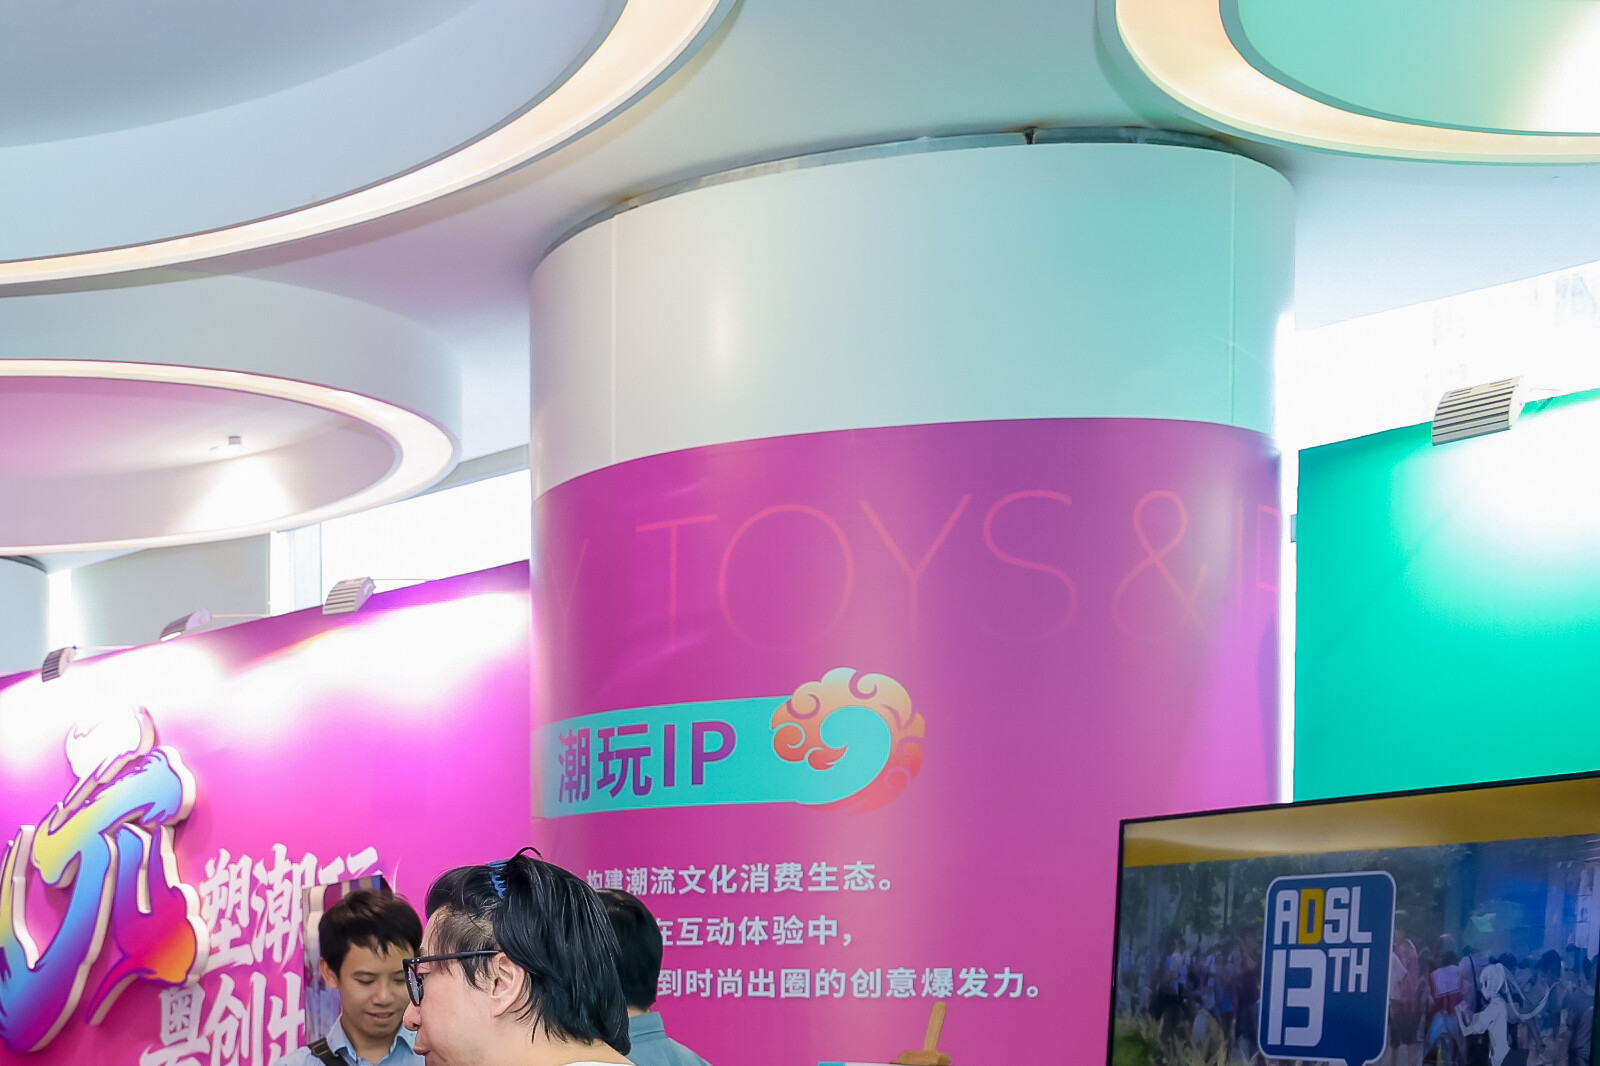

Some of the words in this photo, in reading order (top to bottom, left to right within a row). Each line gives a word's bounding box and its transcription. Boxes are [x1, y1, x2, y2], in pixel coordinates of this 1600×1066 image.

[635, 490, 1079, 652] TOYS
[557, 719, 737, 804] 潮玩IP
[1272, 886, 1373, 946] ADSL
